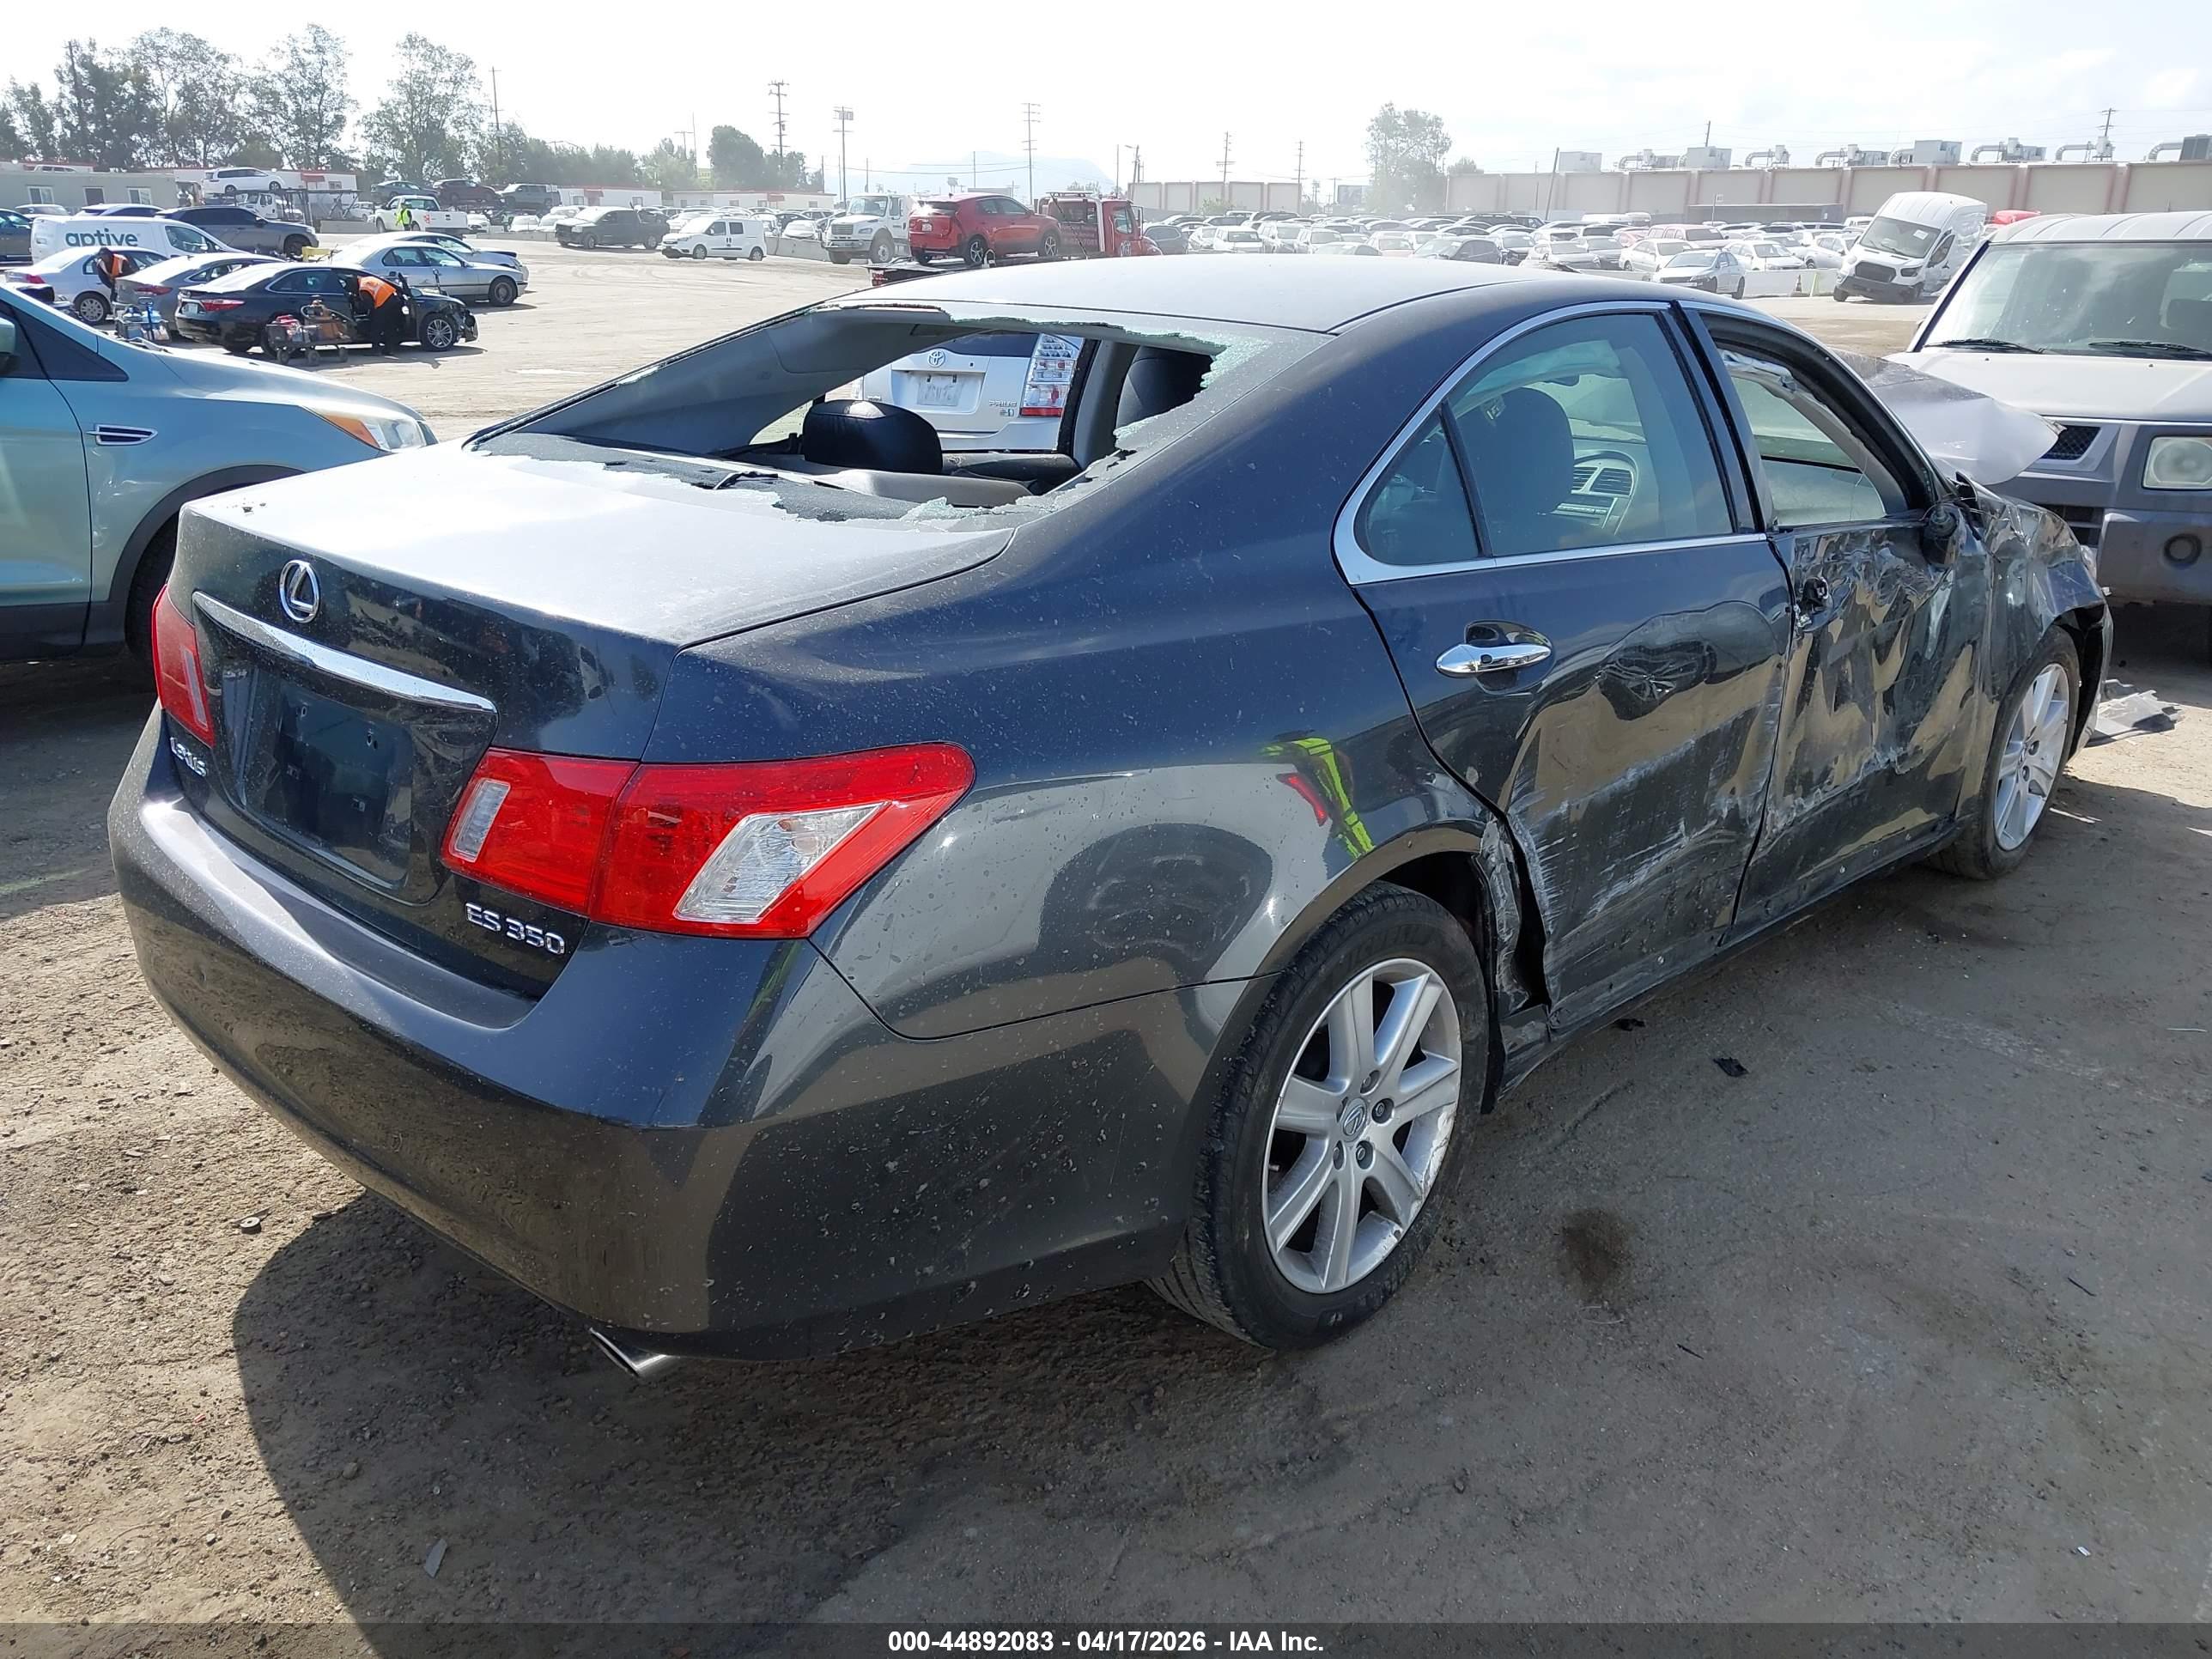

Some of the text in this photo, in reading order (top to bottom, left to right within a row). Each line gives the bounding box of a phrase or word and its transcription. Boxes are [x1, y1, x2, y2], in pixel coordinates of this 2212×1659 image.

[65, 228, 138, 247] aptive
[170, 736, 207, 777] LEXUS
[465, 902, 565, 955] ES 350
